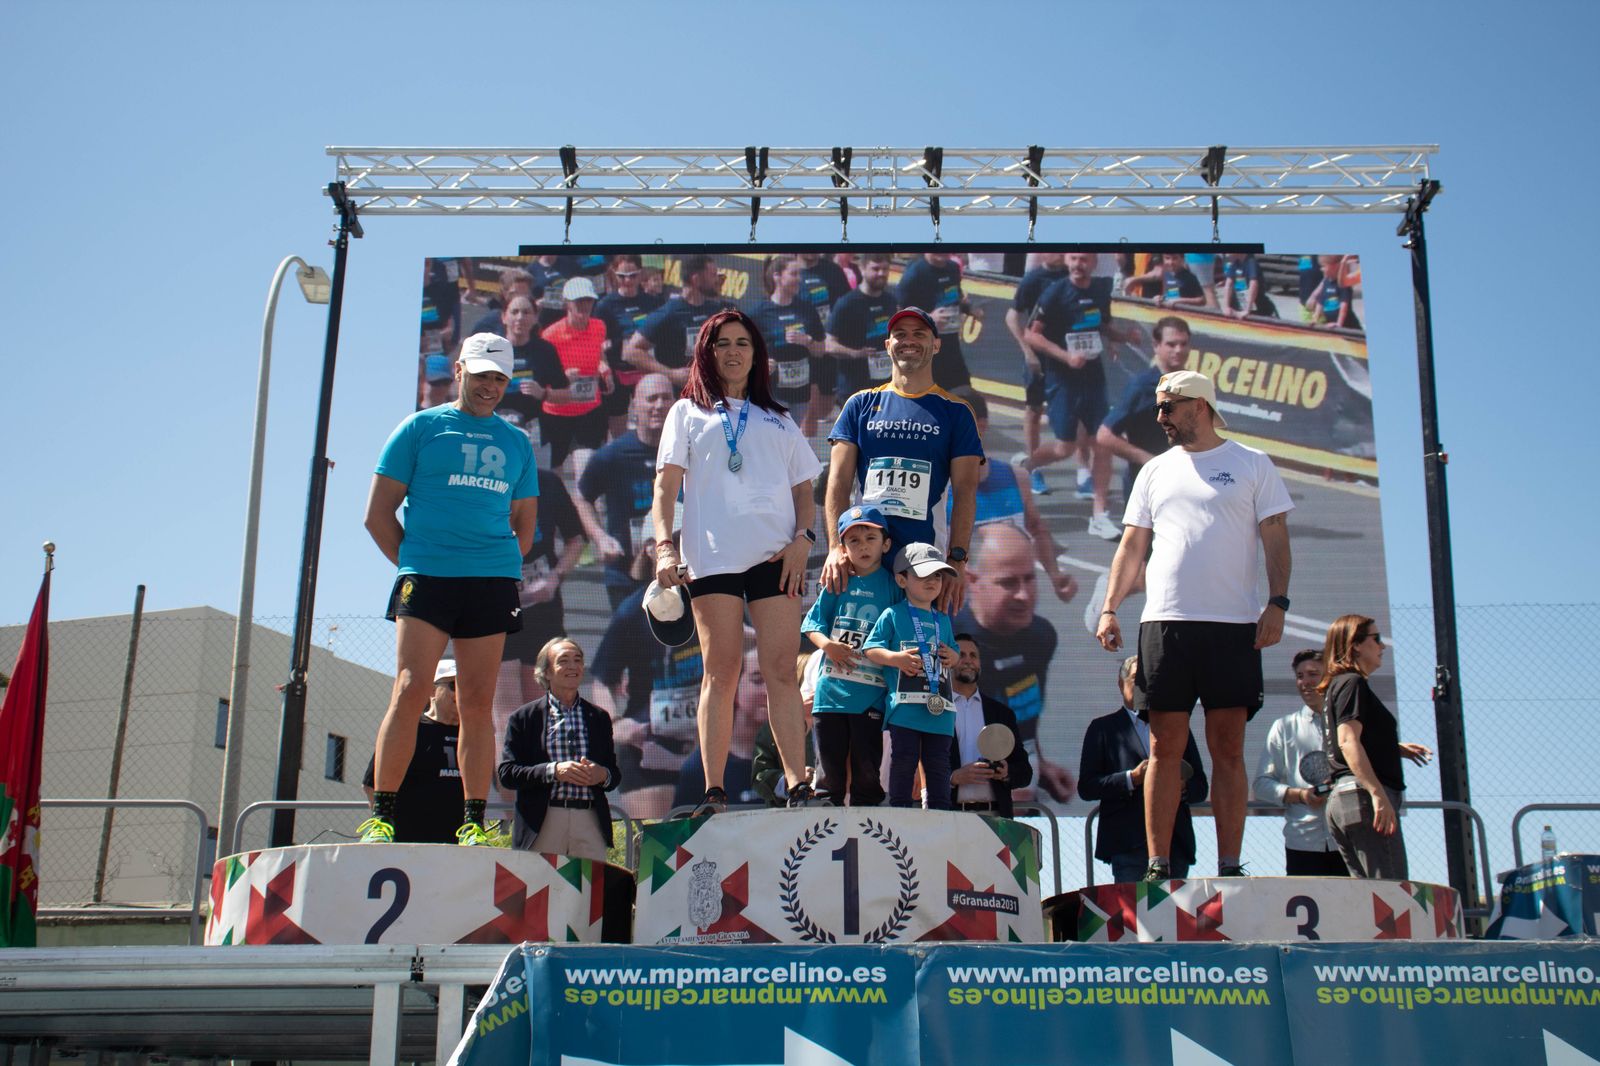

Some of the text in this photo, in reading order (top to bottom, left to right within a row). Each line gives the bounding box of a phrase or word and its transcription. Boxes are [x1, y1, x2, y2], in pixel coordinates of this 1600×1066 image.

[866, 419, 940, 435] agustinos
[876, 432, 927, 440] GRANADA
[461, 443, 507, 479] 18
[448, 474, 509, 494] MARCELINO
[876, 470, 921, 489] 1119
[839, 631, 868, 649] 45
[832, 838, 859, 935] 1
[364, 868, 411, 945] 2
[952, 893, 1017, 911] #Granada2031
[1286, 895, 1320, 941] 3
[718, 931, 750, 940] GRANADA
[564, 962, 887, 989] www.mpmarcelino.es
[947, 961, 1269, 989] www.mpmarcelino.es
[564, 986, 887, 1011] www.mpmarcelino.es
[948, 983, 1271, 1010] www.mpmarcelino.es
